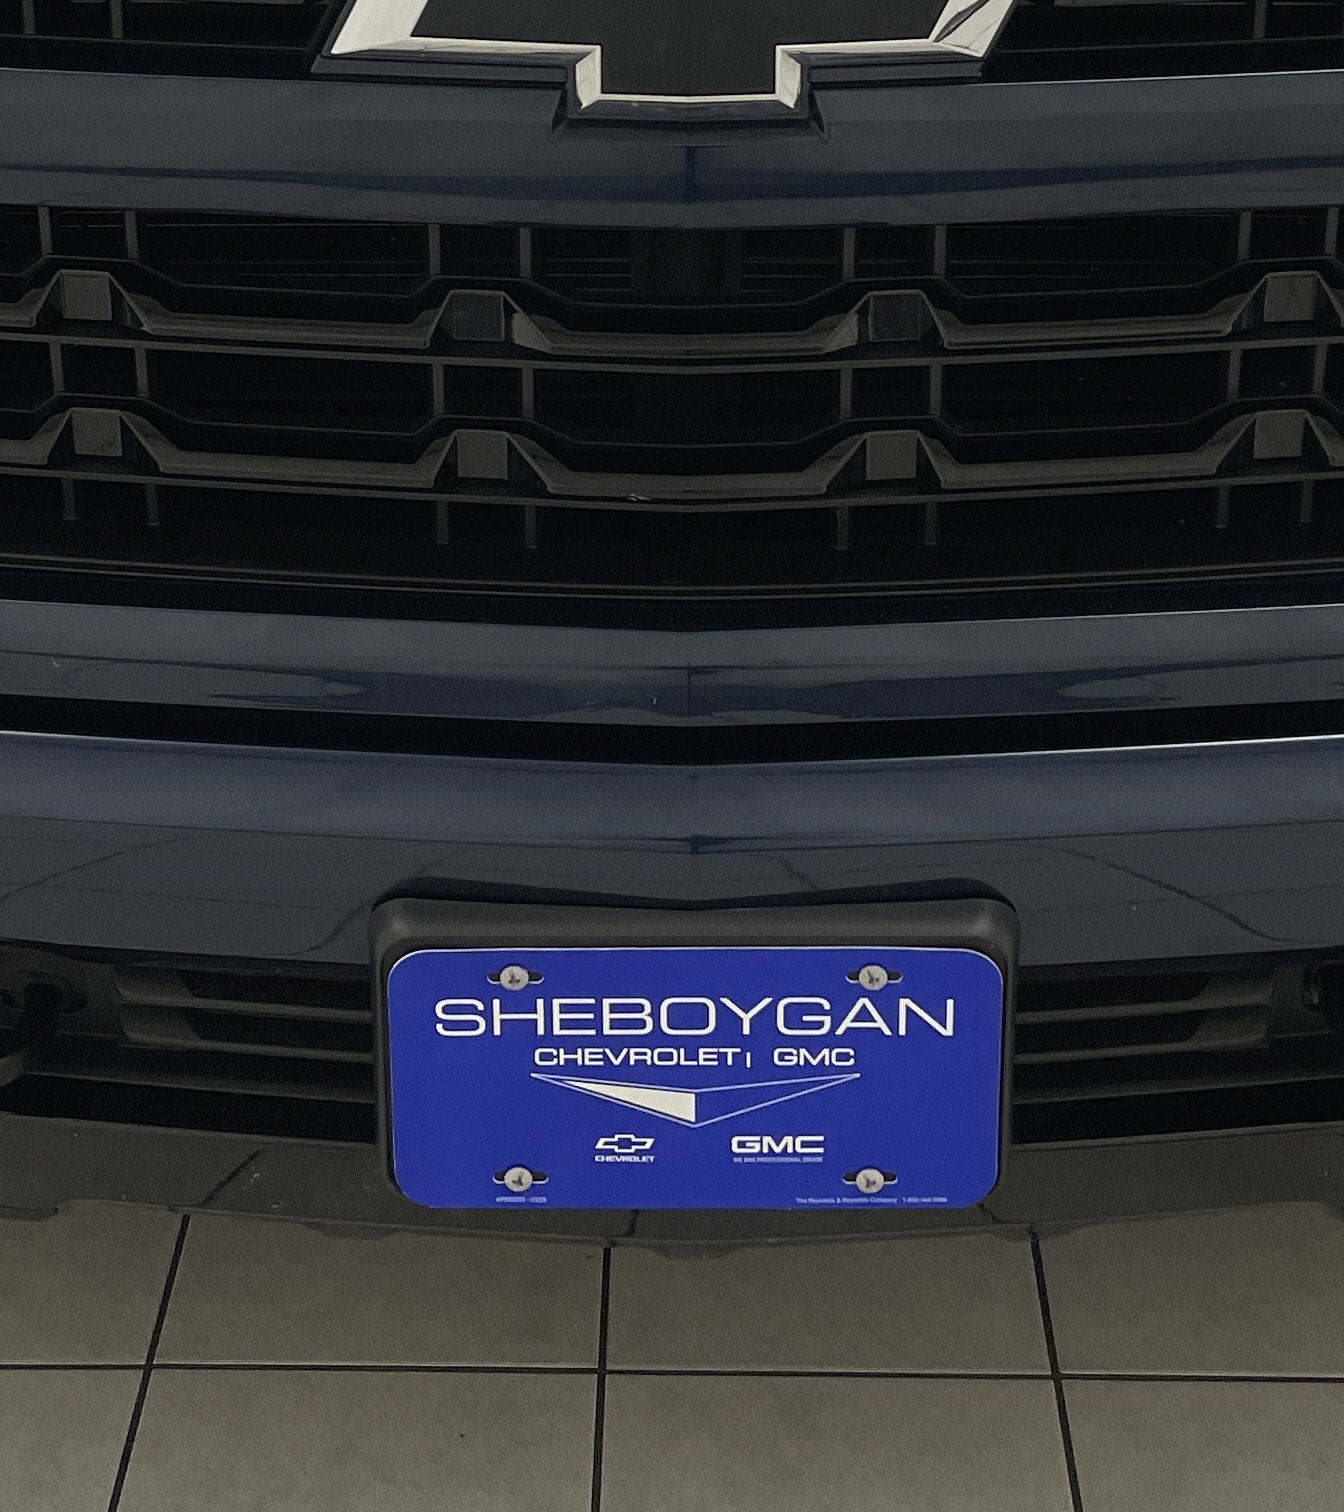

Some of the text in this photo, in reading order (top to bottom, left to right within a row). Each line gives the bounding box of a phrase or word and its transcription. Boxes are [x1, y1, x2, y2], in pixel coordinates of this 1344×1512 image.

[434, 996, 955, 1038] SHEBOYGAN
[533, 1046, 856, 1068] CHEVROLET GMC
[731, 1135, 825, 1154] GMC
[594, 1155, 655, 1163] CHEVROLET
